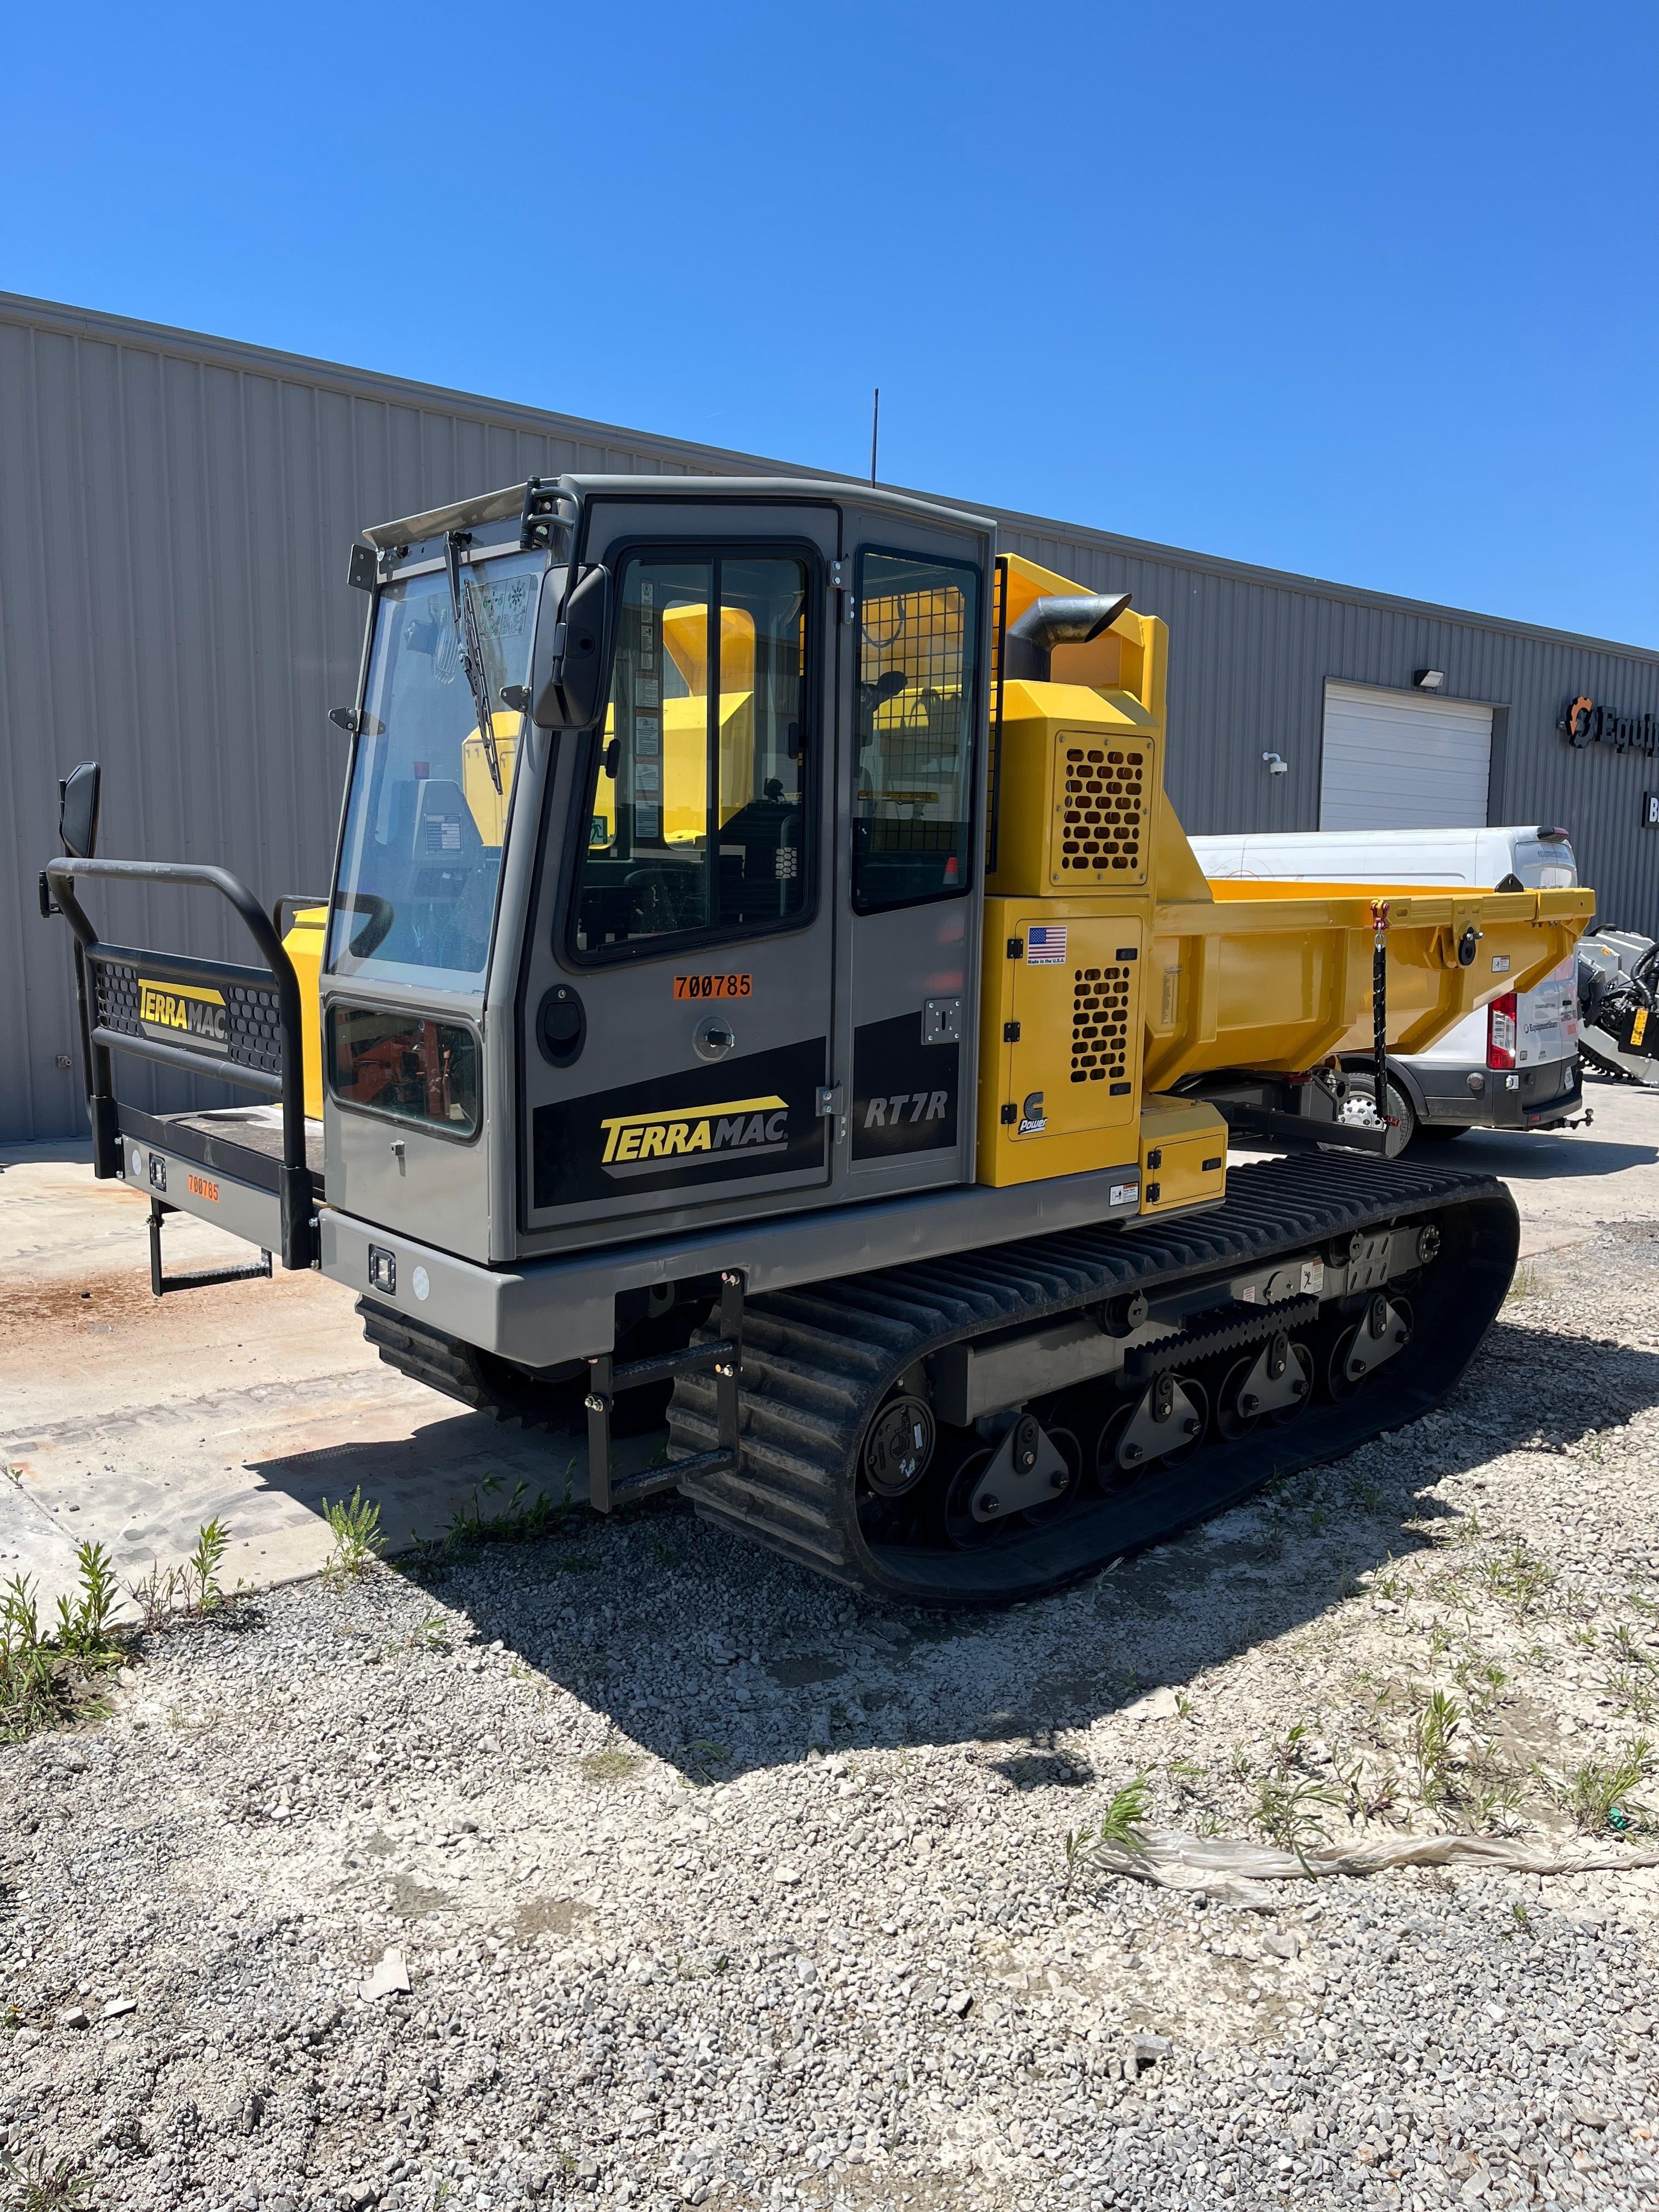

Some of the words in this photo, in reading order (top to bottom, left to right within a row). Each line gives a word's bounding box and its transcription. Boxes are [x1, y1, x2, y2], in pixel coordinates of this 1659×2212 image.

[1649, 797, 1659, 822] B
[676, 975, 751, 997] 700785
[138, 978, 228, 1040] TERRAMAC
[864, 1091, 948, 1128] RT7R
[601, 1096, 789, 1163] TERRAMAC
[1020, 1119, 1048, 1131] Power
[189, 1174, 219, 1200] 700785
